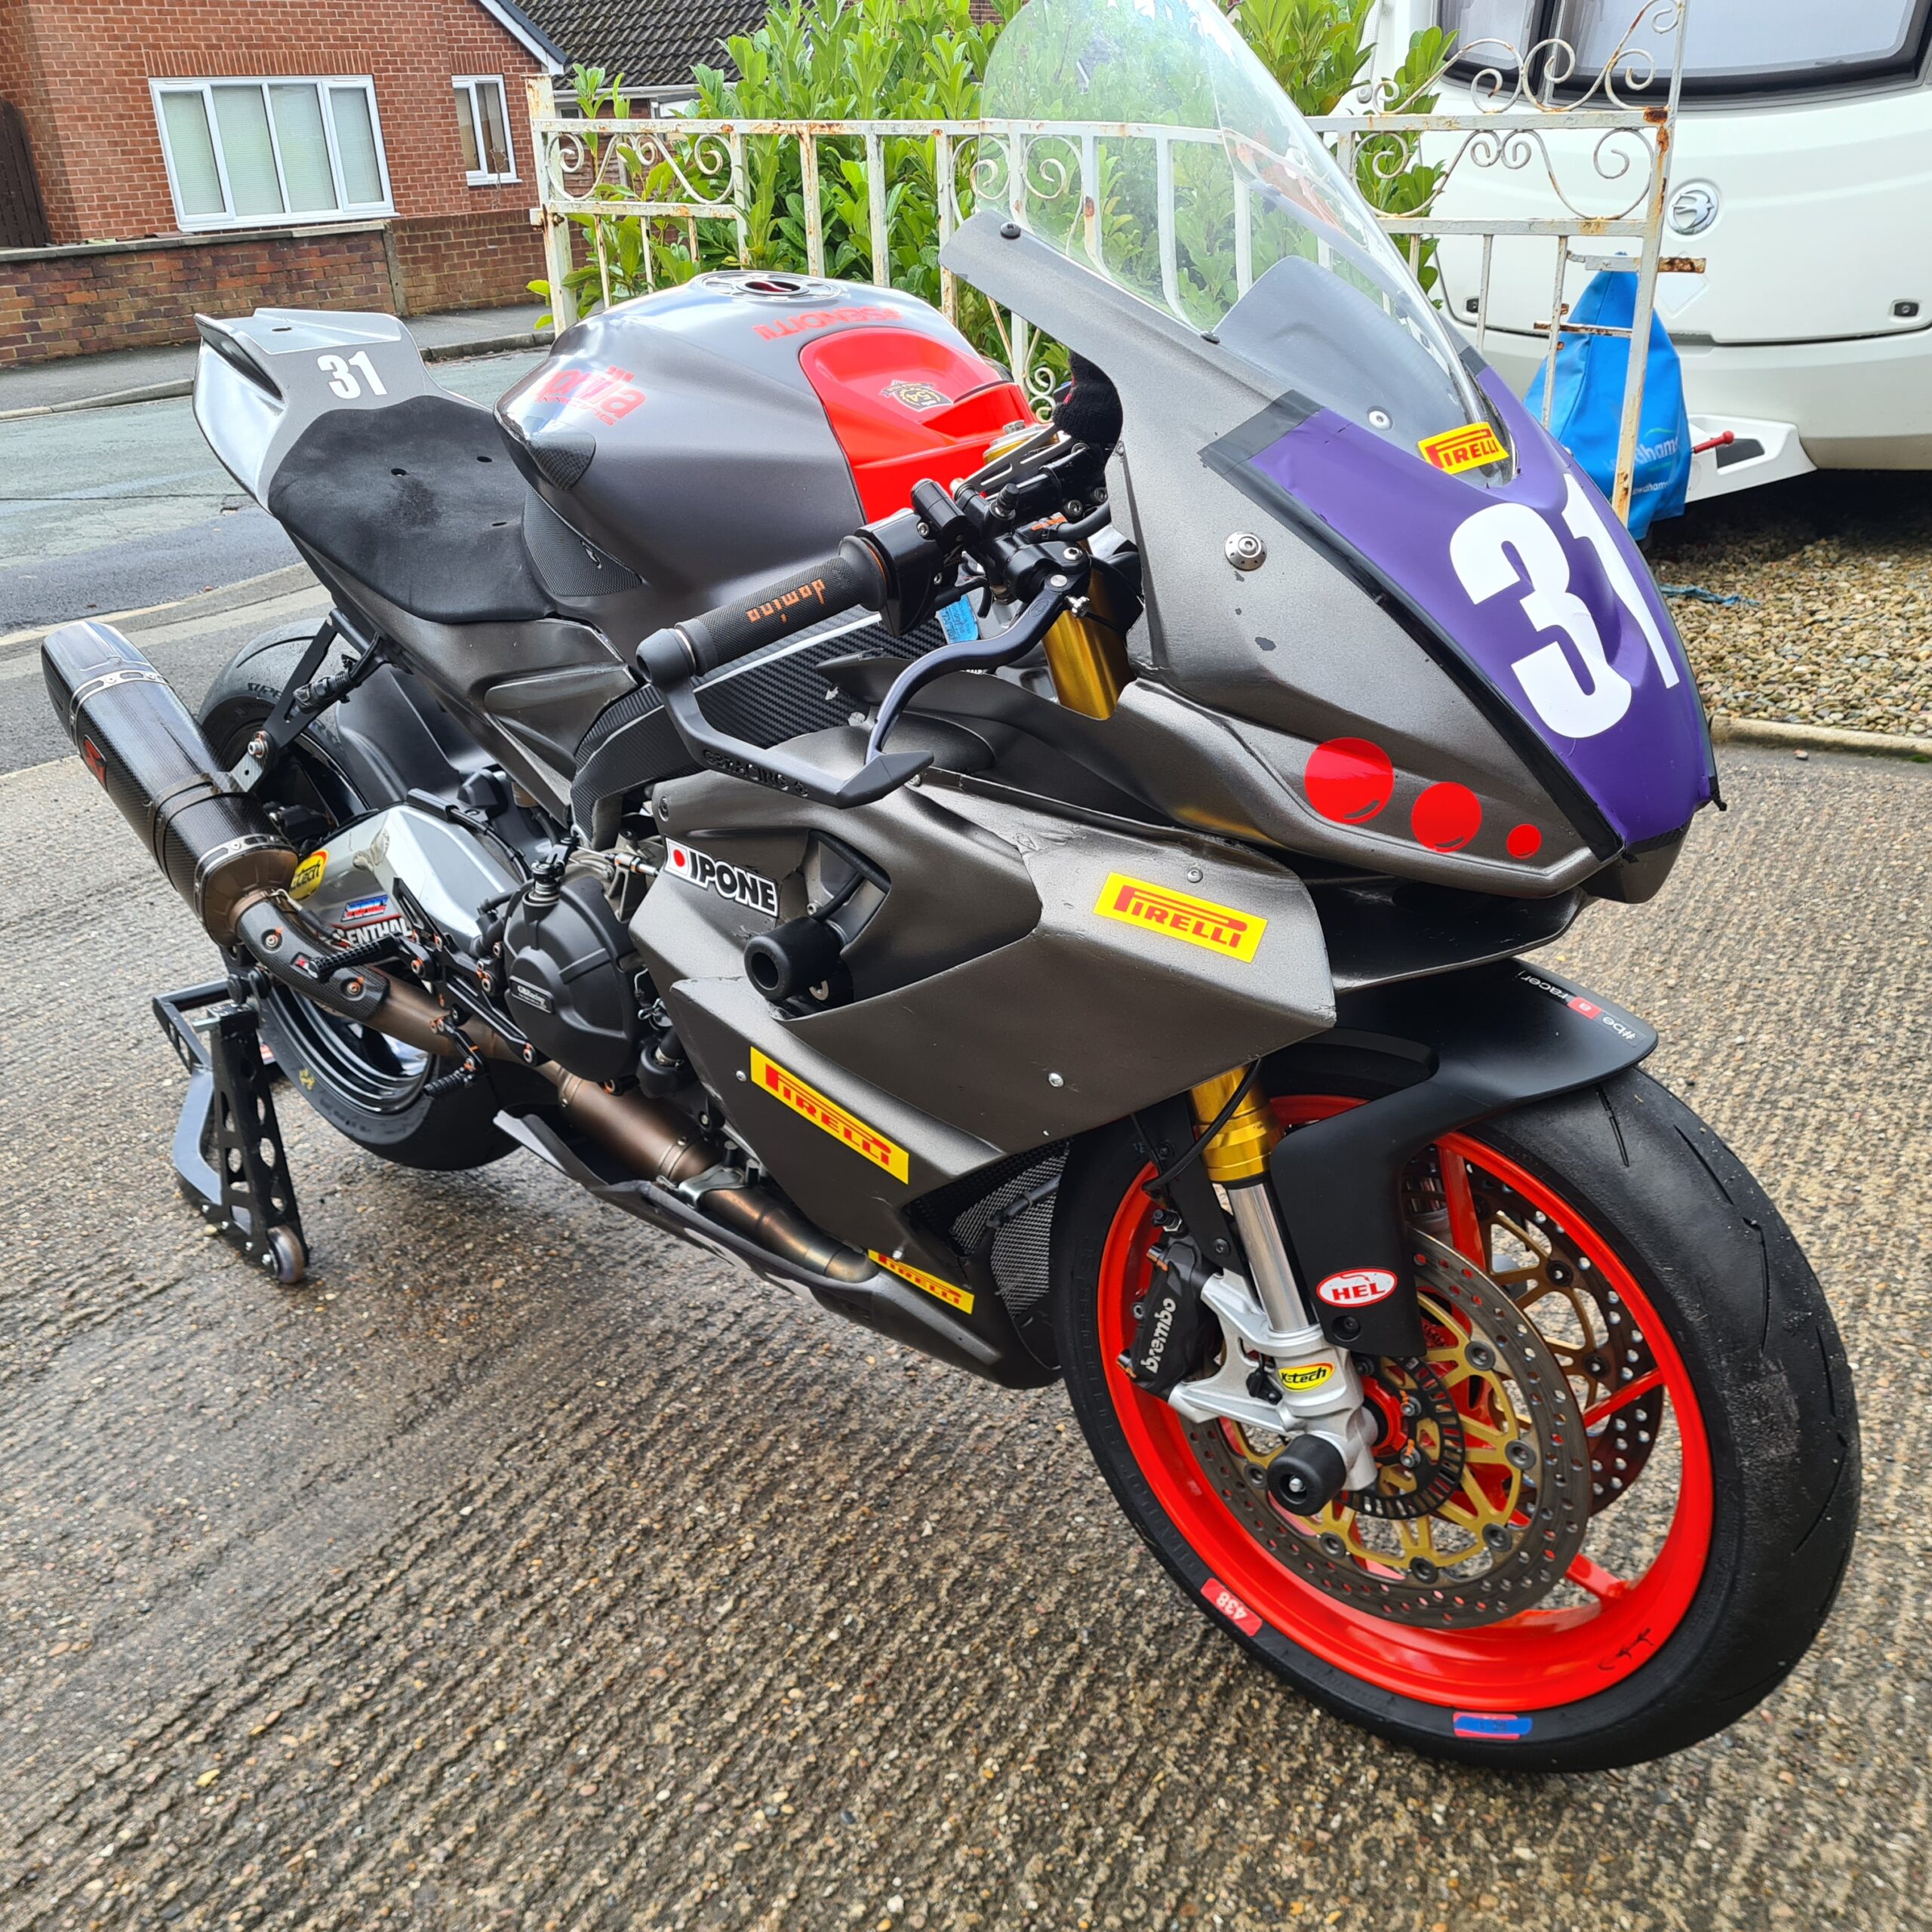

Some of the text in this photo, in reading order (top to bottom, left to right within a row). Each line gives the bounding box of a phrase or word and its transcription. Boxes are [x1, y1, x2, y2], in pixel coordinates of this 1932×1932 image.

[317, 350, 388, 400] 31
[1424, 428, 1500, 469] PIRELLI
[745, 578, 826, 623] domino
[1449, 472, 1681, 739] 31
[689, 850, 776, 912] IPONE
[1113, 884, 1248, 949] PIRELLI
[1602, 1016, 1636, 1041] #be
[765, 1063, 892, 1167] PIRELLI
[878, 1252, 962, 1305] PIRELLI
[1331, 1282, 1386, 1301] HEL
[1140, 1297, 1177, 1374] brembo
[1216, 1591, 1248, 1621] 438
